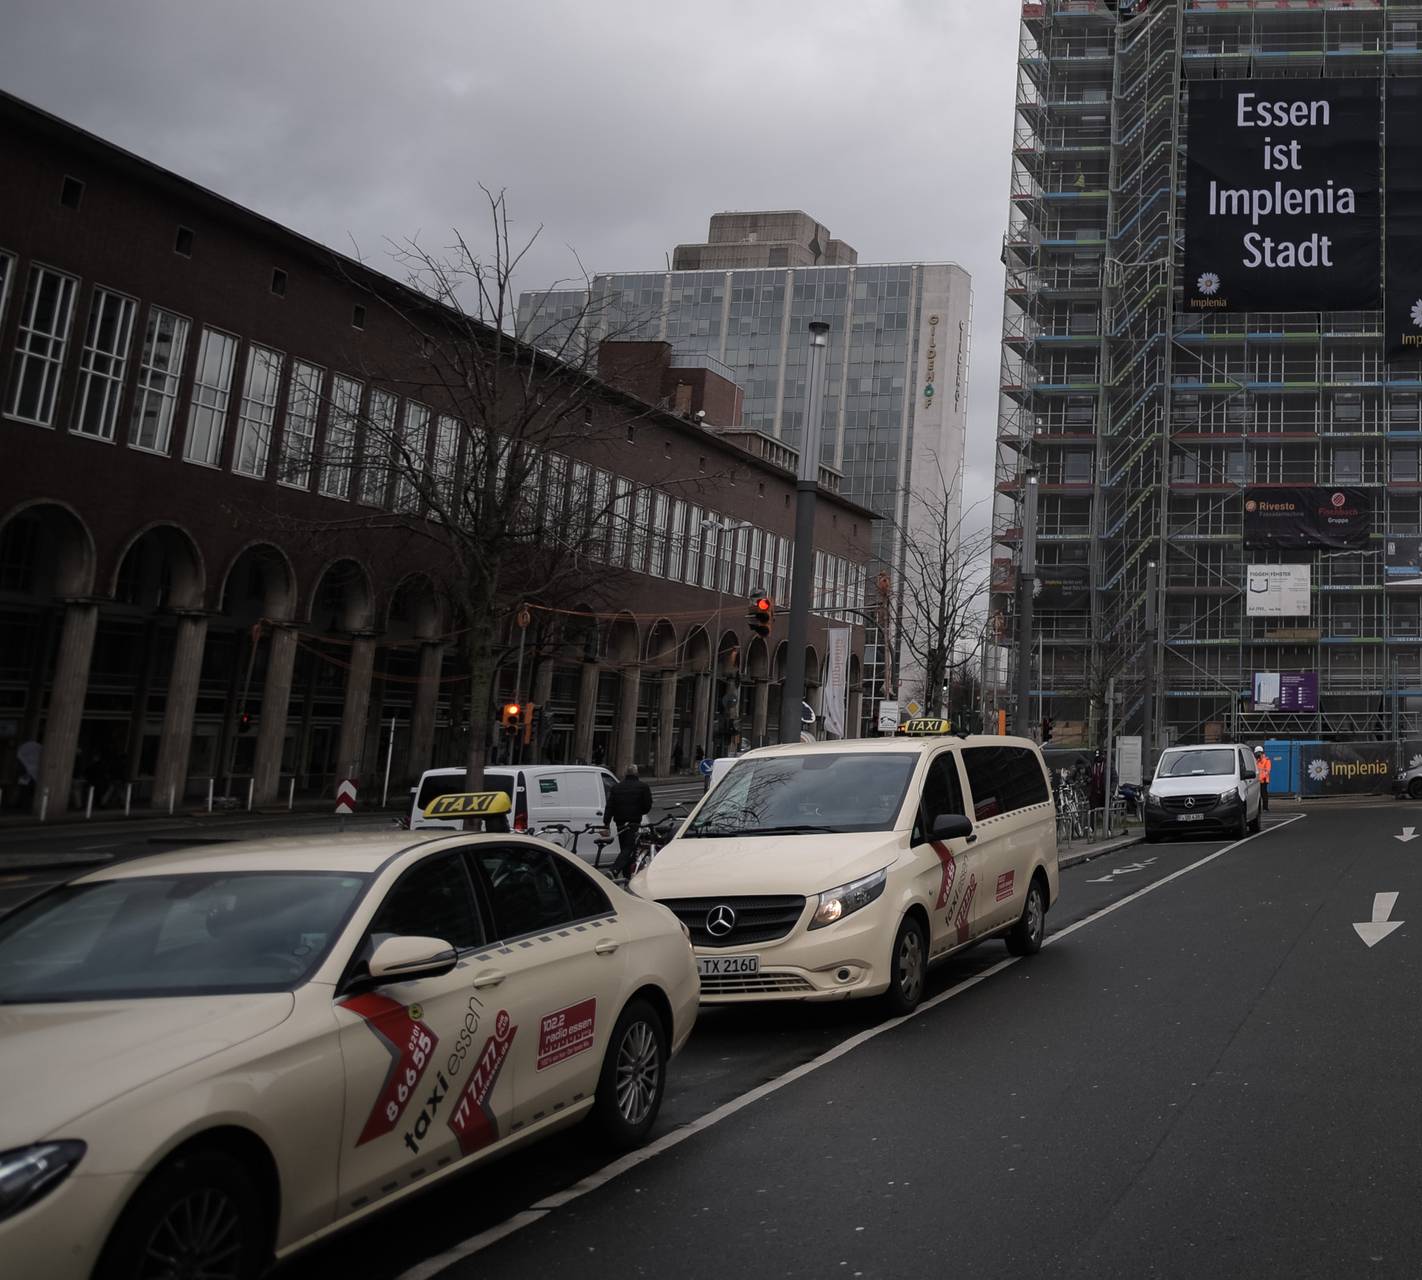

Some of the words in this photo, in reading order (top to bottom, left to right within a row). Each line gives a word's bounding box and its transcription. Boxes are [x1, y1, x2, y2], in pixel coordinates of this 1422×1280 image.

[1236, 92, 1330, 127] Essen
[1263, 136, 1302, 170] ist
[1208, 180, 1356, 225] Implenia
[1242, 233, 1334, 268] Stadt
[1190, 297, 1226, 308] Implenia
[1260, 501, 1295, 511] Rivesta
[911, 720, 939, 730] TAXI
[1331, 760, 1388, 780] Implenia
[438, 795, 493, 812] TAXI
[703, 960, 720, 974] TX
[724, 958, 757, 973] 2160
[408, 1024, 421, 1051] 0201
[545, 1027, 568, 1045] radio
[568, 1018, 593, 1035] essen
[404, 1070, 450, 1154] taxi
[447, 996, 485, 1076] essen
